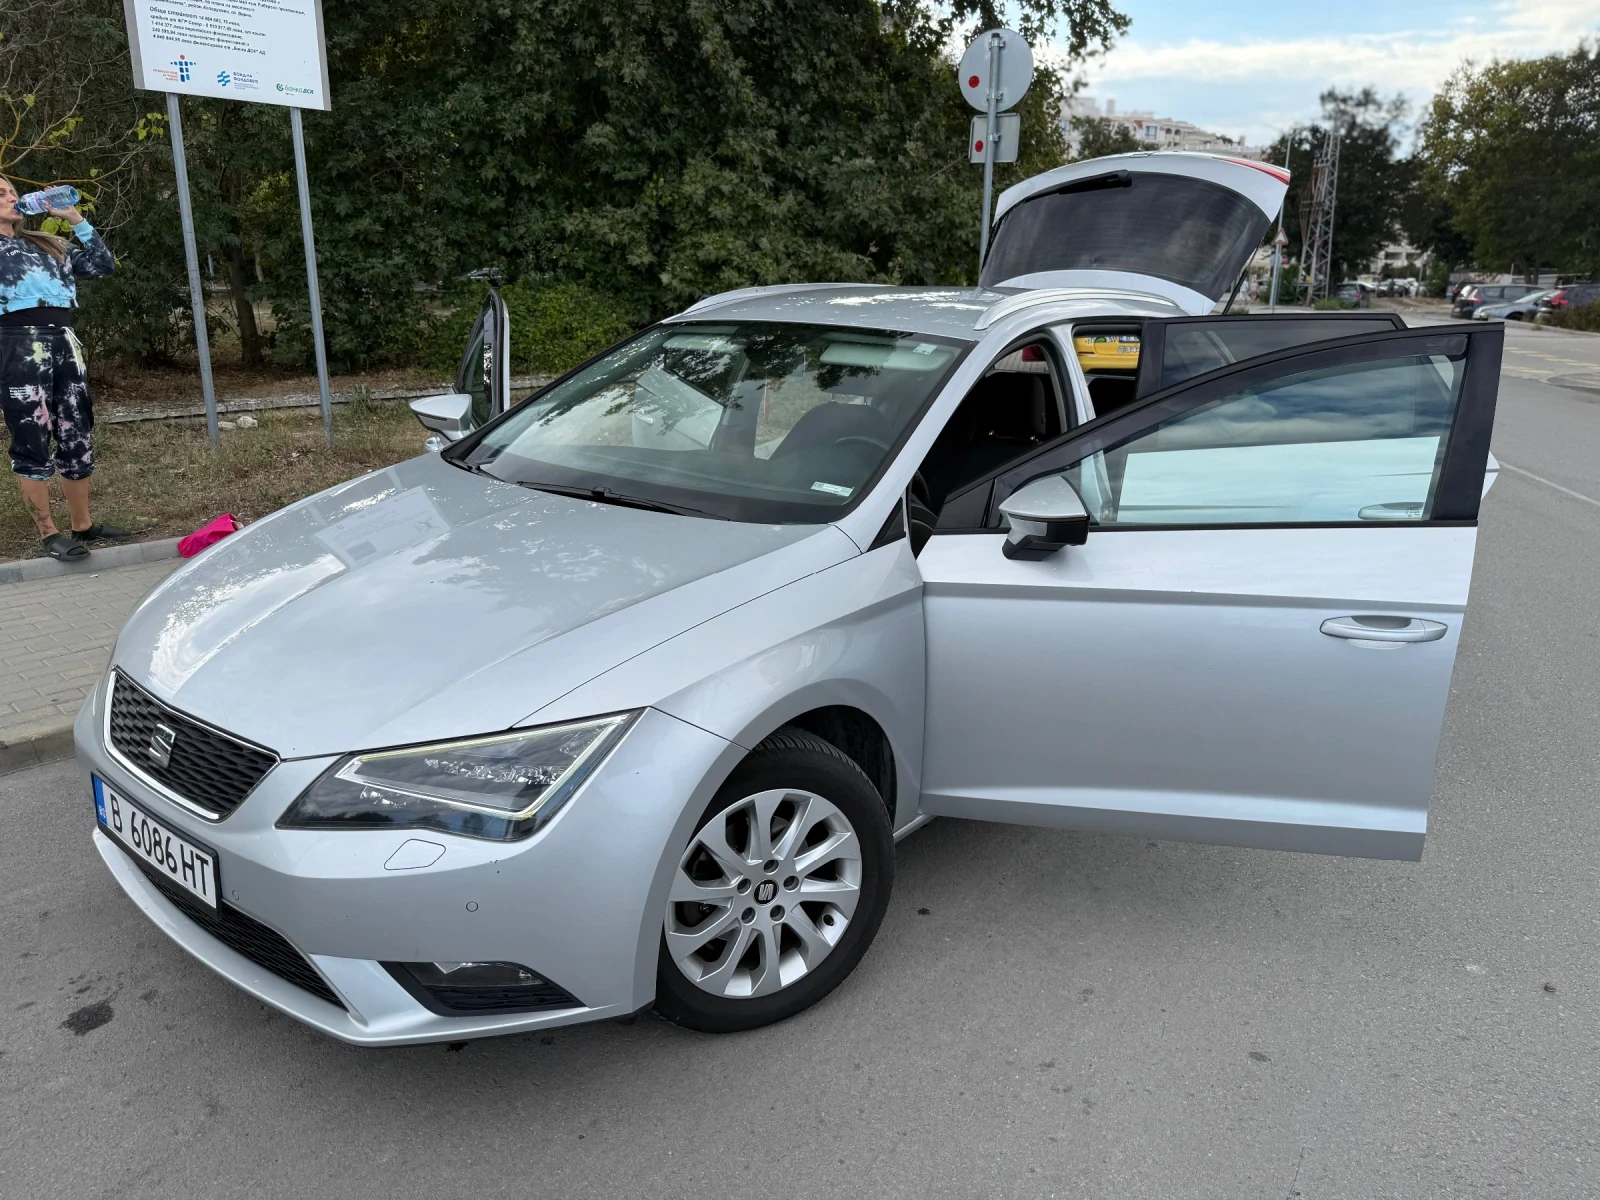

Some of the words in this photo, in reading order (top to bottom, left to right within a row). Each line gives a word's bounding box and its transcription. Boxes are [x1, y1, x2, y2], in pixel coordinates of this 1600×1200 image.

[150, 6, 166, 14] Обща
[168, 10, 197, 19] стойност
[110, 792, 122, 833] B
[131, 811, 178, 874] 6086
[180, 844, 209, 896] HT
